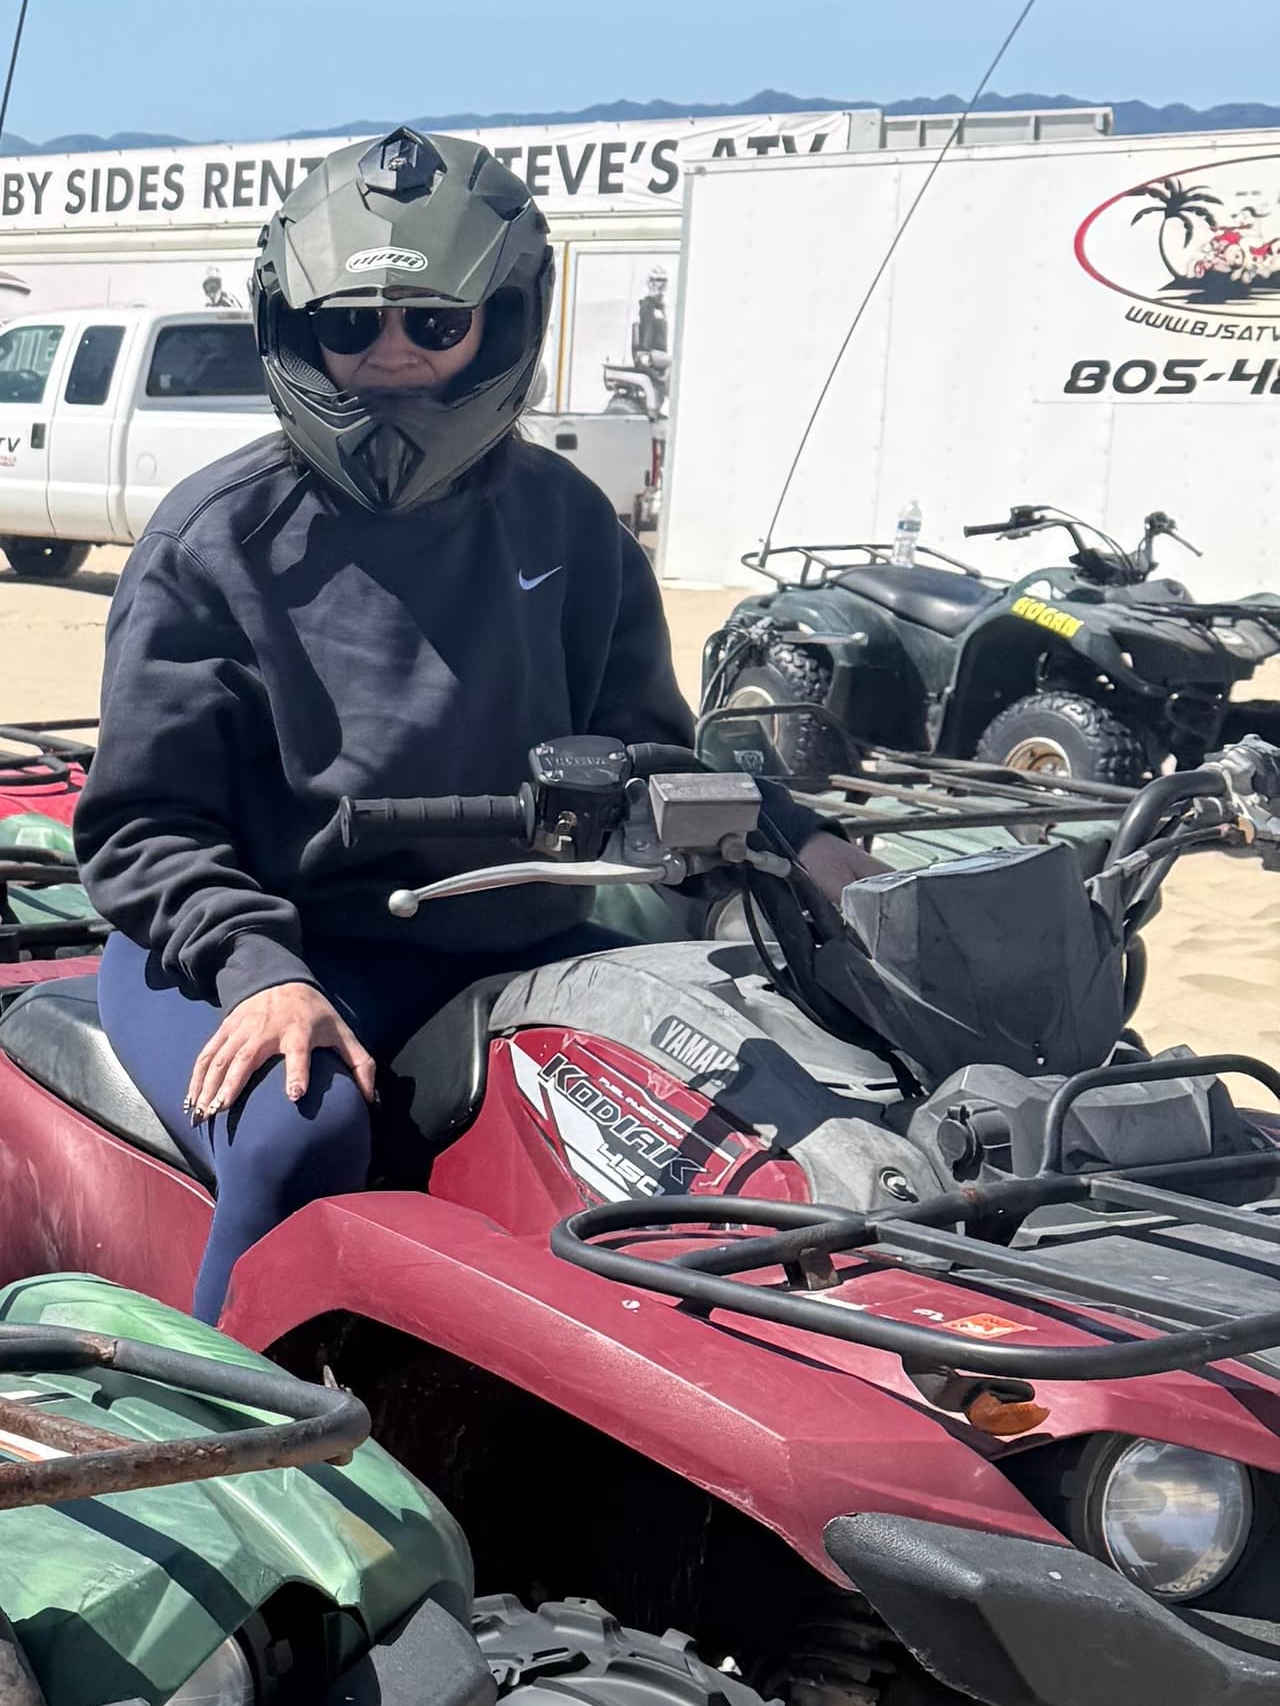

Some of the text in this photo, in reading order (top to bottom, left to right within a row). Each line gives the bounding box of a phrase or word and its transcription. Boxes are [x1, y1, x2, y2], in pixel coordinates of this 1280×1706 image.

[2, 171, 53, 216] BY
[64, 163, 185, 215] SIDES
[1063, 358, 1280, 395] 805-4
[658, 1018, 740, 1073] YAMAH
[537, 1052, 709, 1186] KODIAK
[596, 1143, 666, 1197] 450
